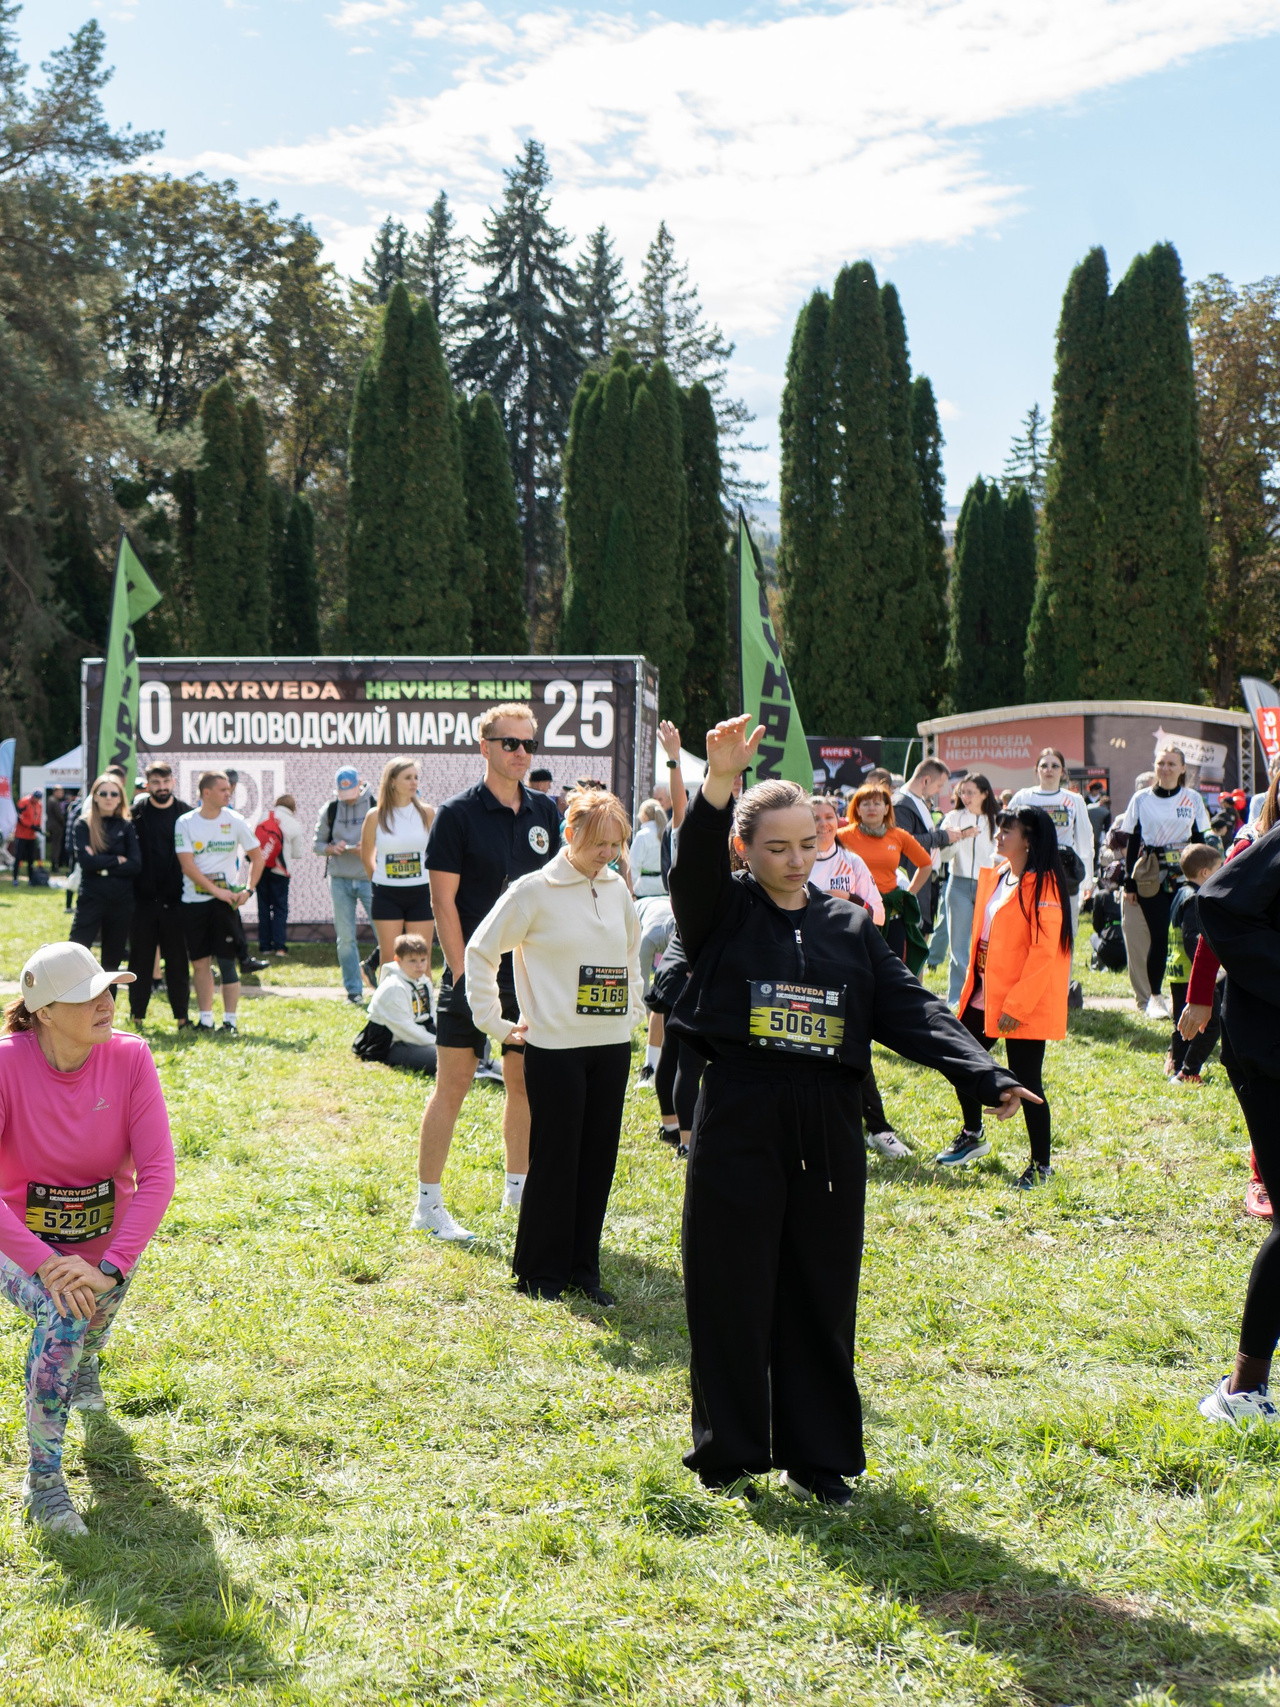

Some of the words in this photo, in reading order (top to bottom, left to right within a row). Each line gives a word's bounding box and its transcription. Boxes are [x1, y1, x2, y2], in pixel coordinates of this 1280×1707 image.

[181, 681, 340, 700] MAYRVEDA
[543, 680, 614, 749] 25
[182, 705, 391, 749] КИСЛОВОДСКИЙ
[946, 736, 978, 747] ТВОЯ
[981, 734, 1033, 747] ПОБЕДА
[821, 747, 851, 757] HYPER
[946, 747, 1030, 760] НЕСЛУЧАЙНА
[590, 987, 624, 1003] 5169
[775, 984, 824, 997] MAYRVEDA
[770, 1010, 827, 1039] 5064
[49, 1187, 97, 1196] MAYRVEDA
[43, 1208, 102, 1229] 5220
